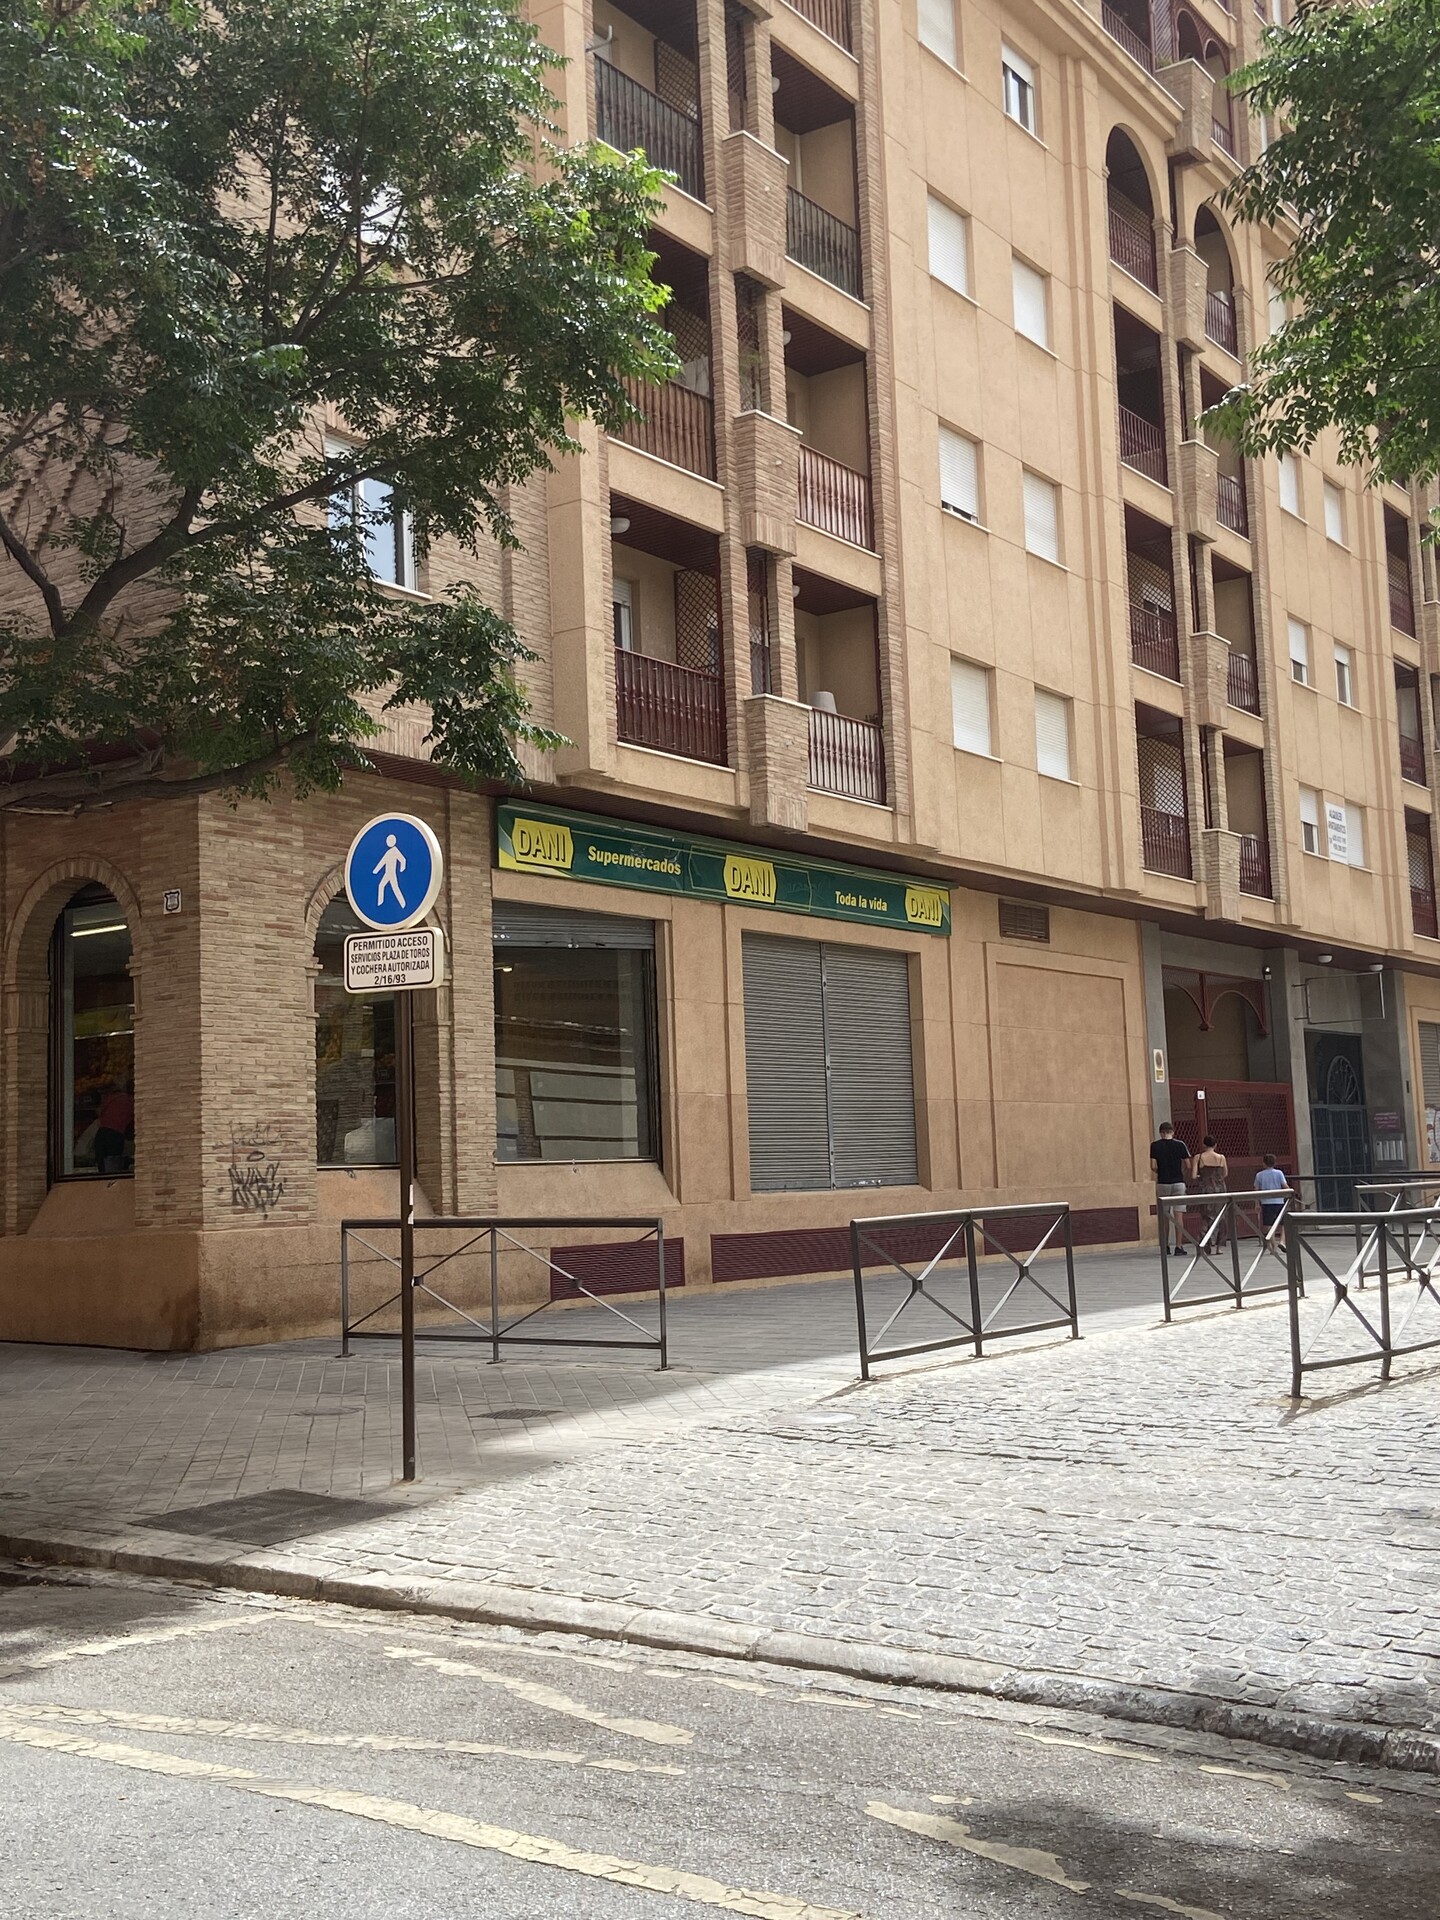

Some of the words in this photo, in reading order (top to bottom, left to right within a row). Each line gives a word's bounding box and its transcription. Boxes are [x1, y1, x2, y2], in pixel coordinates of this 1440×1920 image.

[518, 826, 566, 862] DANI
[588, 846, 681, 875] Supermercados
[730, 861, 772, 898] DANI
[835, 891, 857, 907] Toda
[858, 893, 867, 908] la
[869, 896, 888, 911] vida
[910, 896, 940, 922] DANI
[353, 939, 396, 951] PERMITIDO
[397, 936, 428, 947] ACCESO
[350, 952, 381, 964] SERVICIOS
[382, 950, 400, 961] PLAZA
[401, 949, 409, 959] DE
[410, 948, 430, 958] TOROS
[351, 966, 356, 975] Y
[356, 963, 387, 975] COCHERA
[387, 960, 430, 973] AUTORIZADA
[374, 974, 406, 985] 2/16/93
